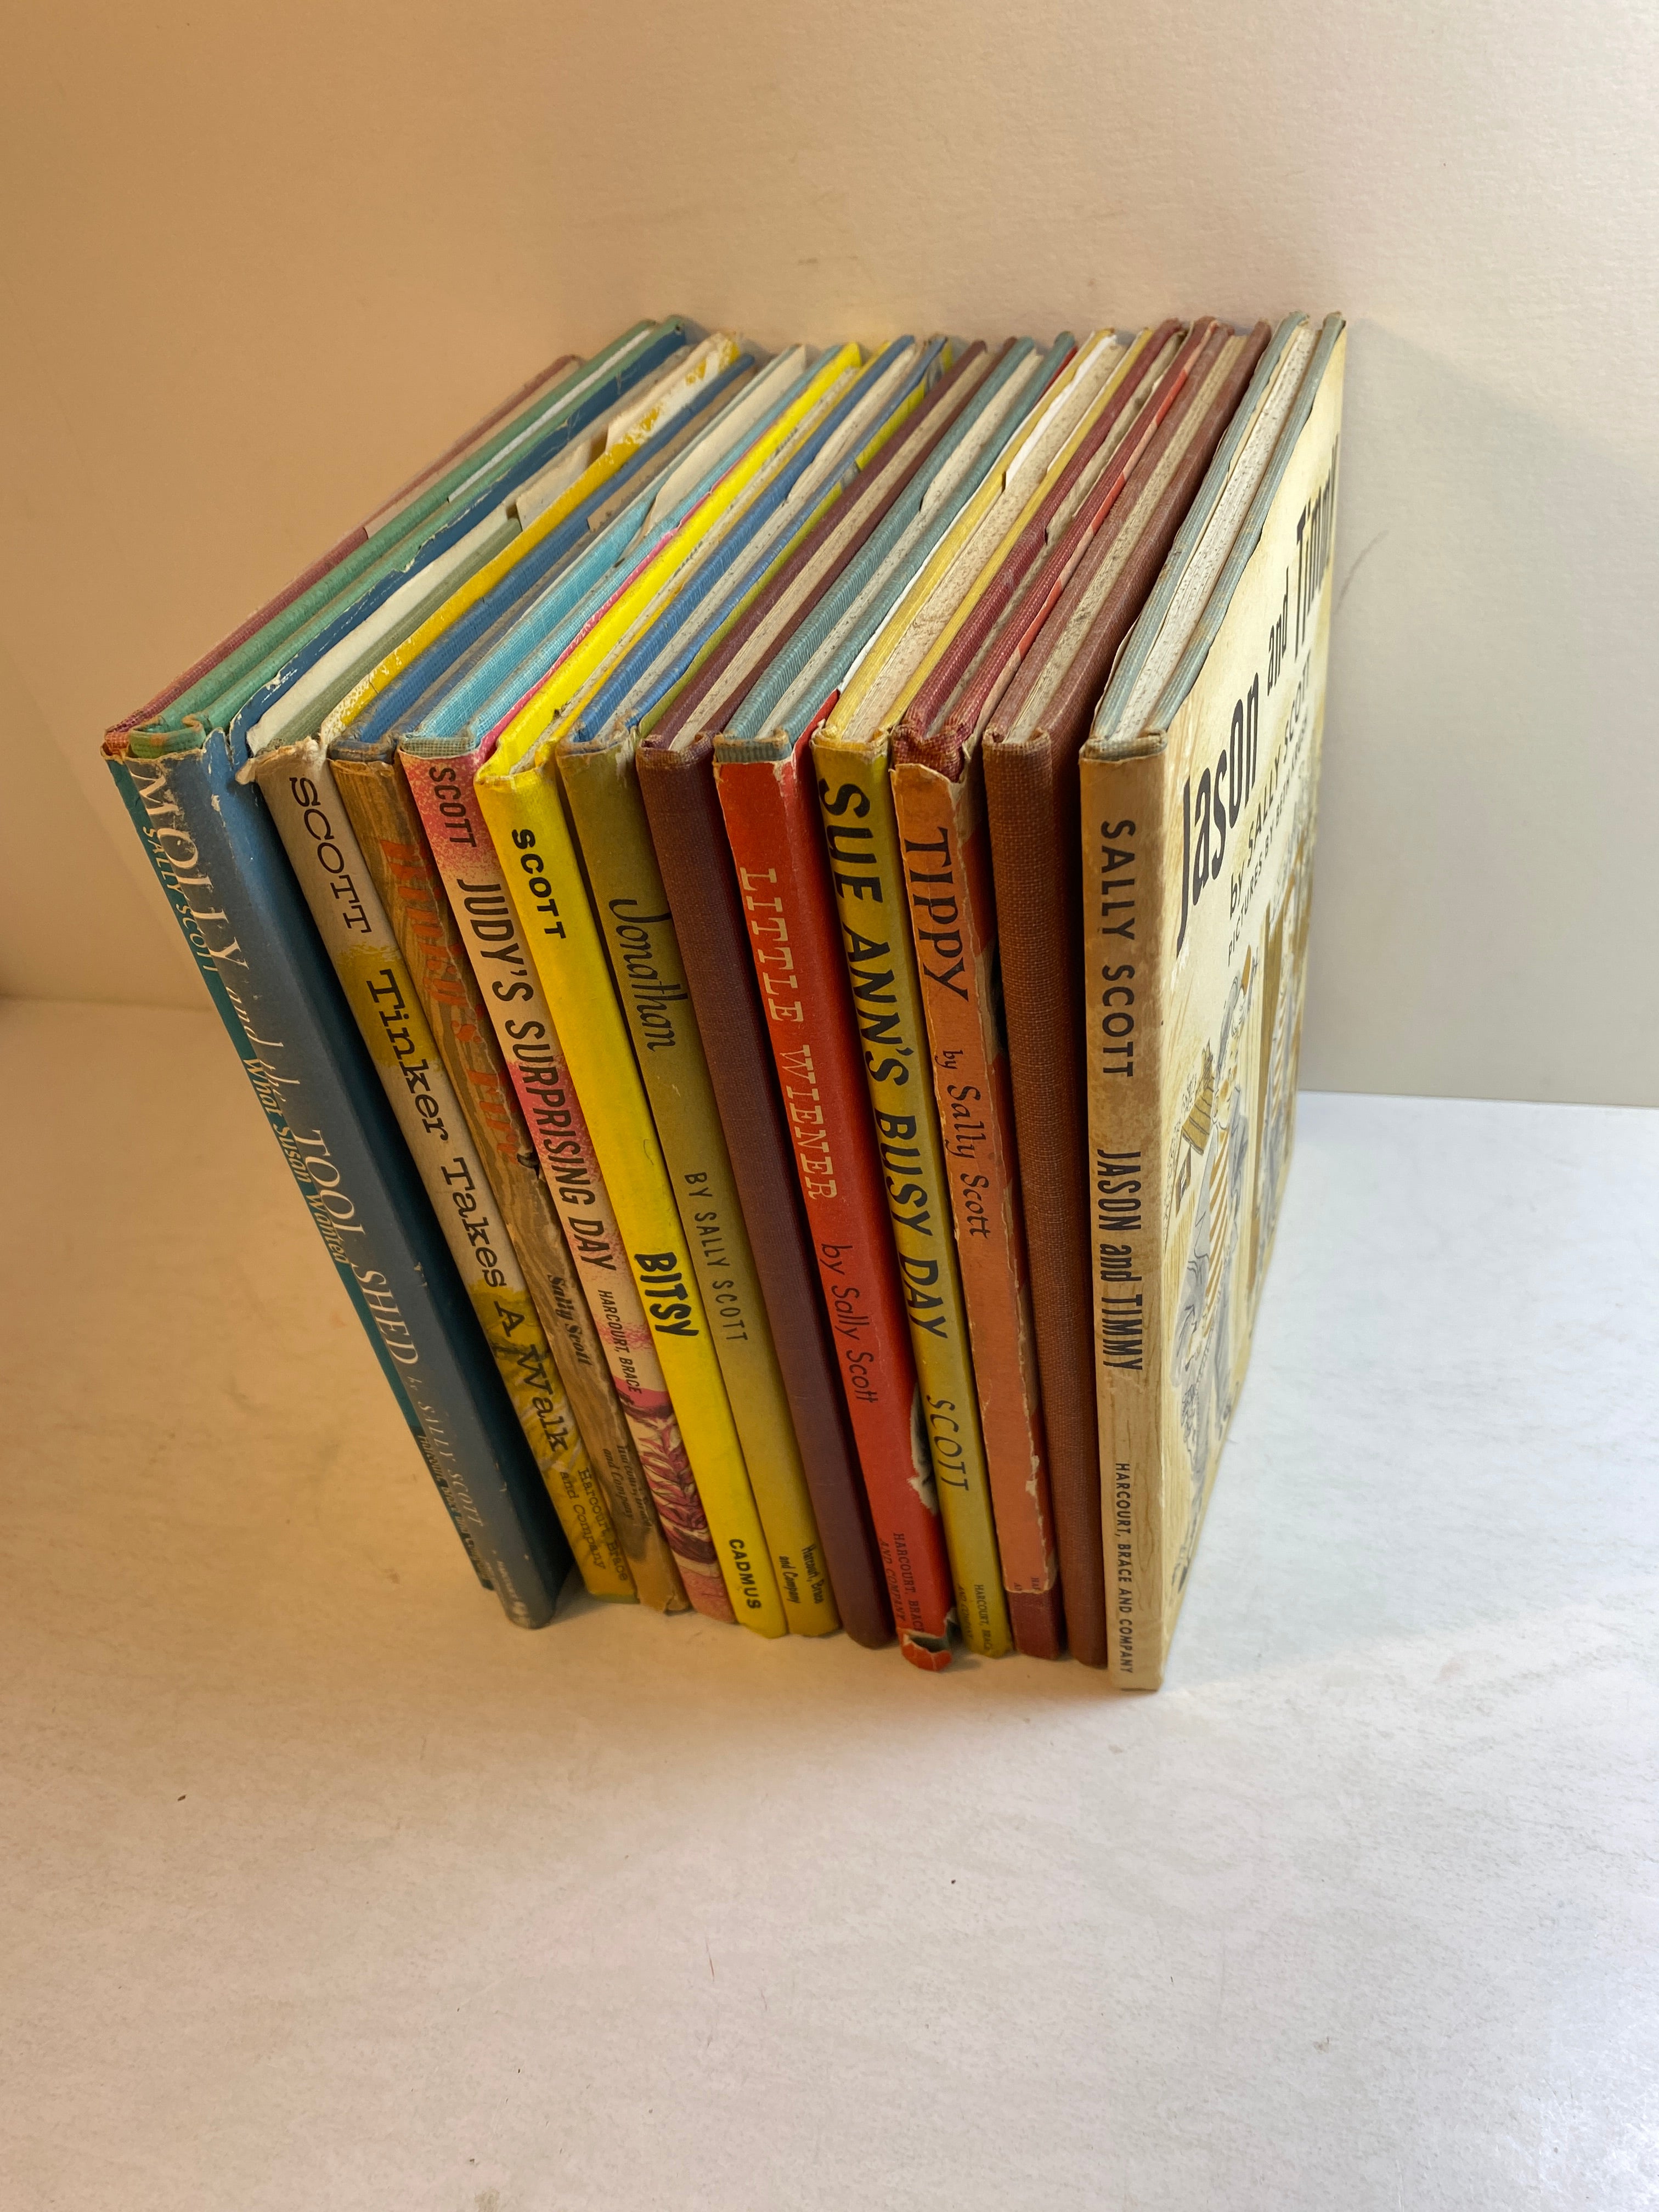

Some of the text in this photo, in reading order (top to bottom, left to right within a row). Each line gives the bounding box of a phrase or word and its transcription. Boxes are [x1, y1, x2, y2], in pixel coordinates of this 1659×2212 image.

[1176, 672, 1259, 958] Jason
[1267, 566, 1289, 696] and
[1229, 648, 1311, 920] by SALLY SCOTT
[1227, 851, 1262, 967] PICTURES
[1264, 819, 1274, 859] BY
[130, 766, 249, 969] MOLLY
[291, 1130, 365, 1240] TOOL
[351, 1263, 418, 1364] SHED
[244, 1058, 283, 1117] What
[273, 1121, 312, 1184] Susan
[289, 776, 568, 1452] SCOTT Tinker Takes A Walk
[429, 767, 642, 1395] SCOTT JUDY'S SURPRISING DAY HARCOURT, BRACE
[608, 899, 748, 1342] Jonathan BY SALLY SCOTT
[740, 867, 878, 1404] LITTLE WIENER by Sally Scott
[817, 778, 970, 1491] SUE ANN'S BUSY DAY SCOTT
[904, 826, 991, 1239] TIPPY by Sally Scott
[512, 829, 761, 1609] SCOTT BITSY CADMUS
[547, 1273, 592, 1365] Sally Scott
[1097, 819, 1143, 1674] SALLY SCOTT JASON and TIMMY HARCOURT, BRACE AND COMPANY
[418, 1401, 455, 1462] SALLY
[447, 1469, 483, 1527] SCOTT
[560, 1471, 606, 1570] and Company
[603, 1448, 634, 1520] and Company
[607, 1540, 628, 1581] Brace
[779, 1556, 801, 1604] and Company
[801, 1543, 825, 1604] Harcourt, Brace
[879, 1537, 906, 1622] AND COMPANY
[974, 1584, 990, 1626] HARCOURT,
